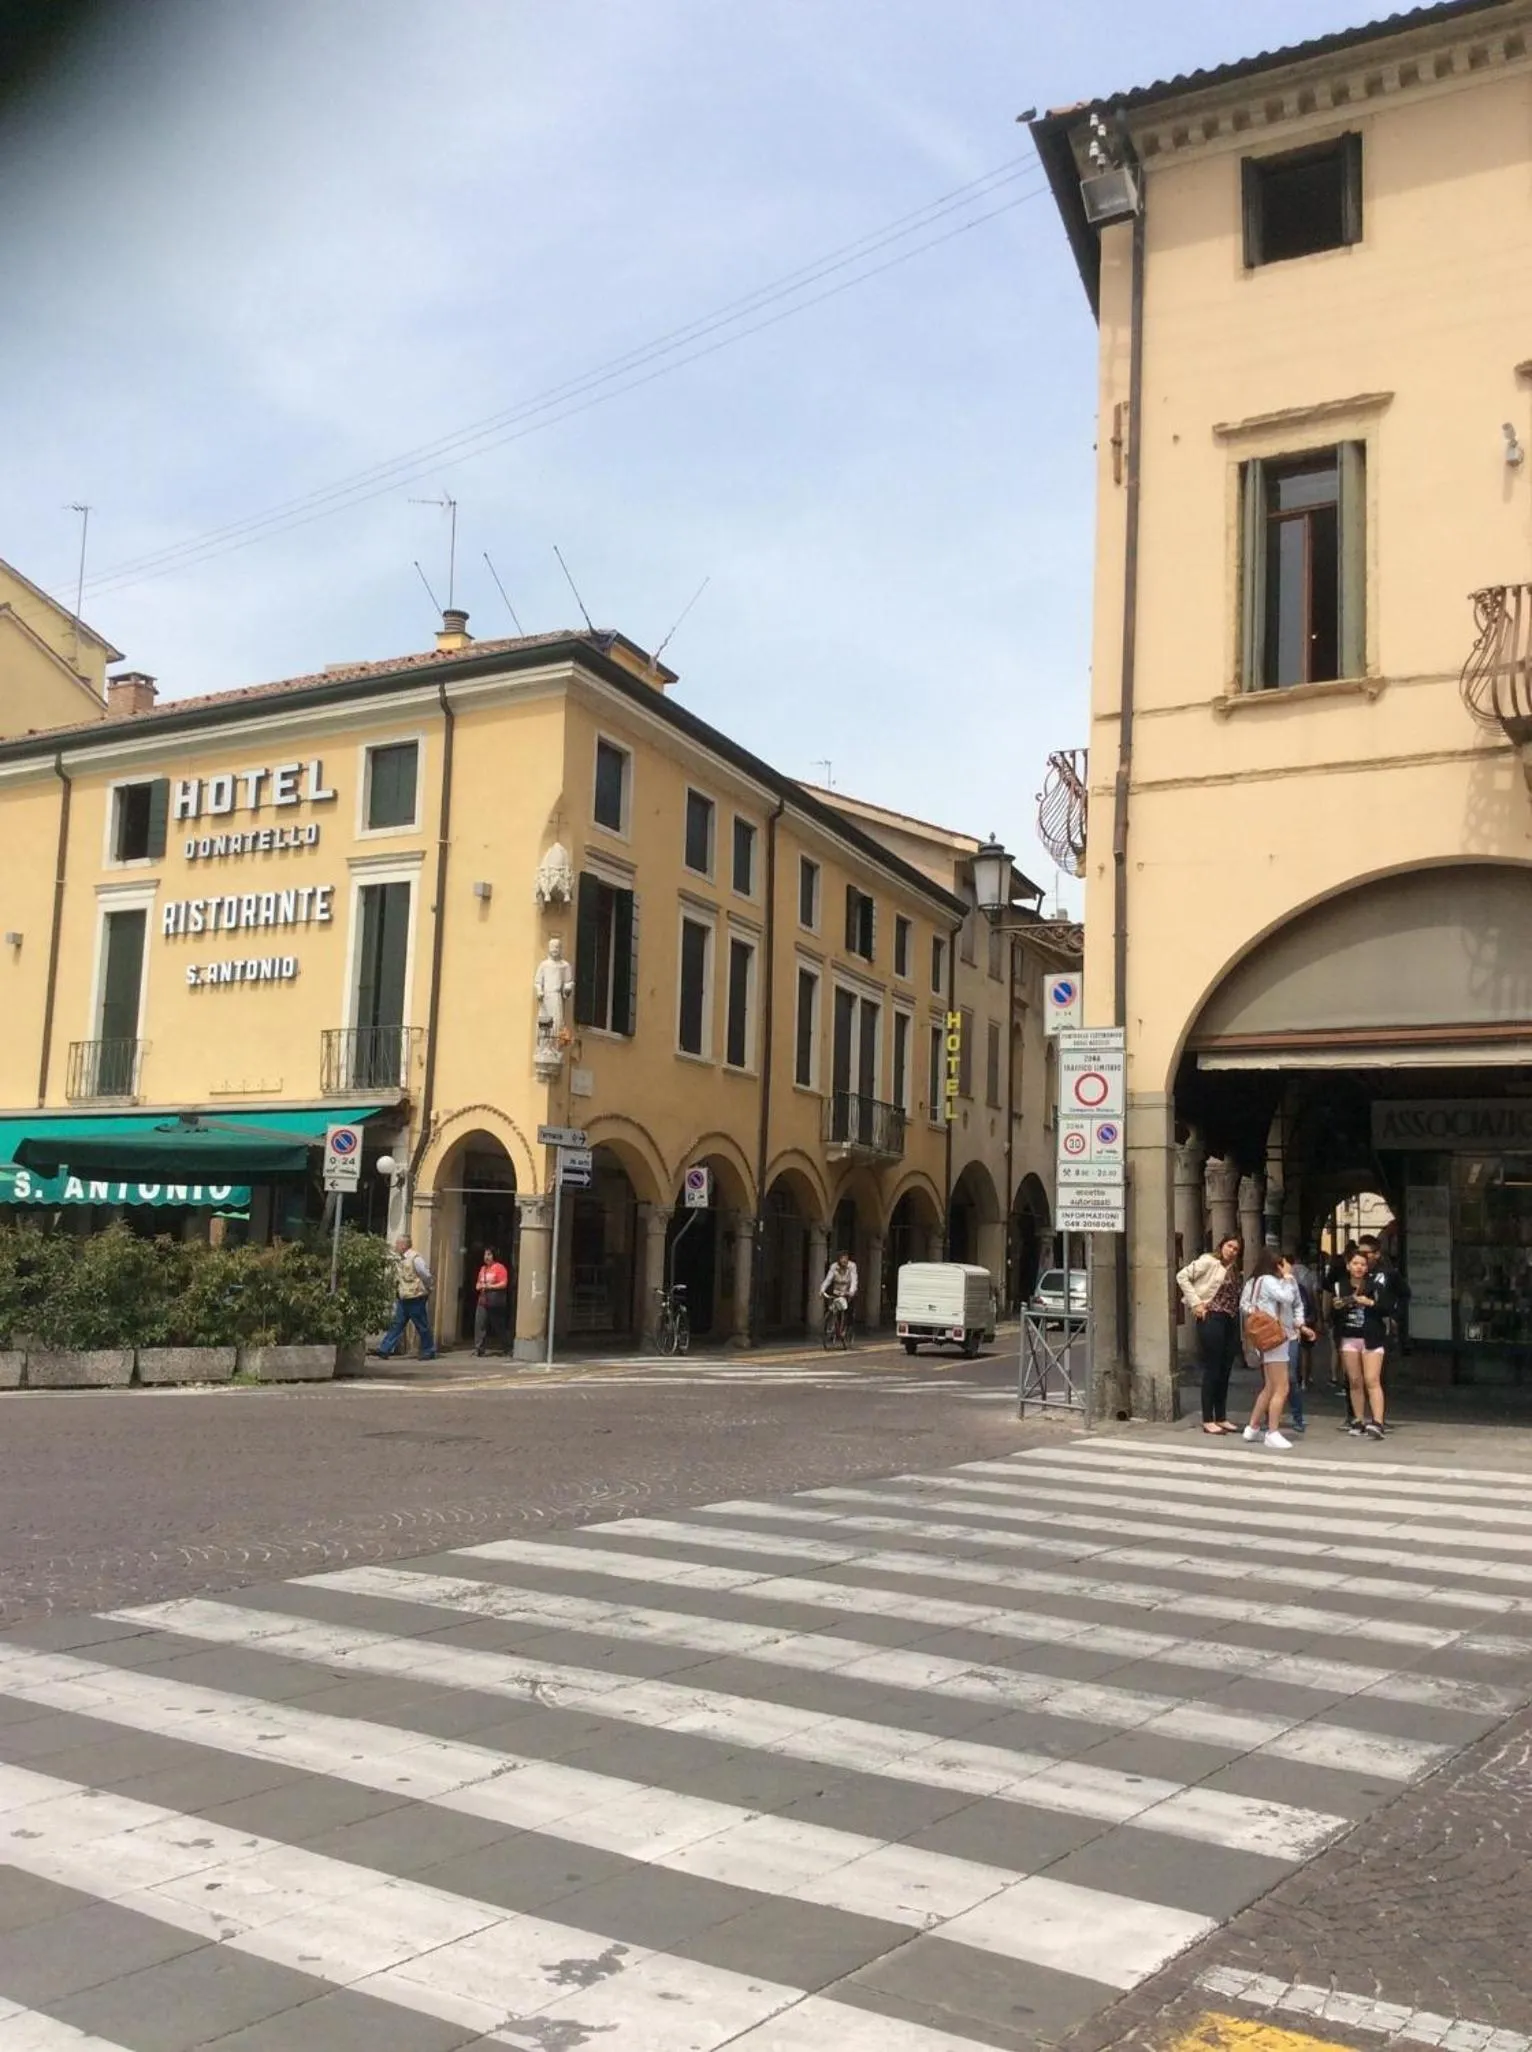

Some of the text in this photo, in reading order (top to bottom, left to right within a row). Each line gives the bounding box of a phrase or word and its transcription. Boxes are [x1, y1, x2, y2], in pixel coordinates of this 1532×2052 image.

[173, 760, 335, 820] HOTEL
[184, 824, 319, 859] DONATELLO
[163, 886, 334, 935] RISTORANTE
[186, 956, 297, 985] S. ANTONIO
[945, 1011, 961, 1120] HOTEL
[1069, 1139, 1081, 1148] 30
[14, 1171, 232, 1200] S. ANTONIO
